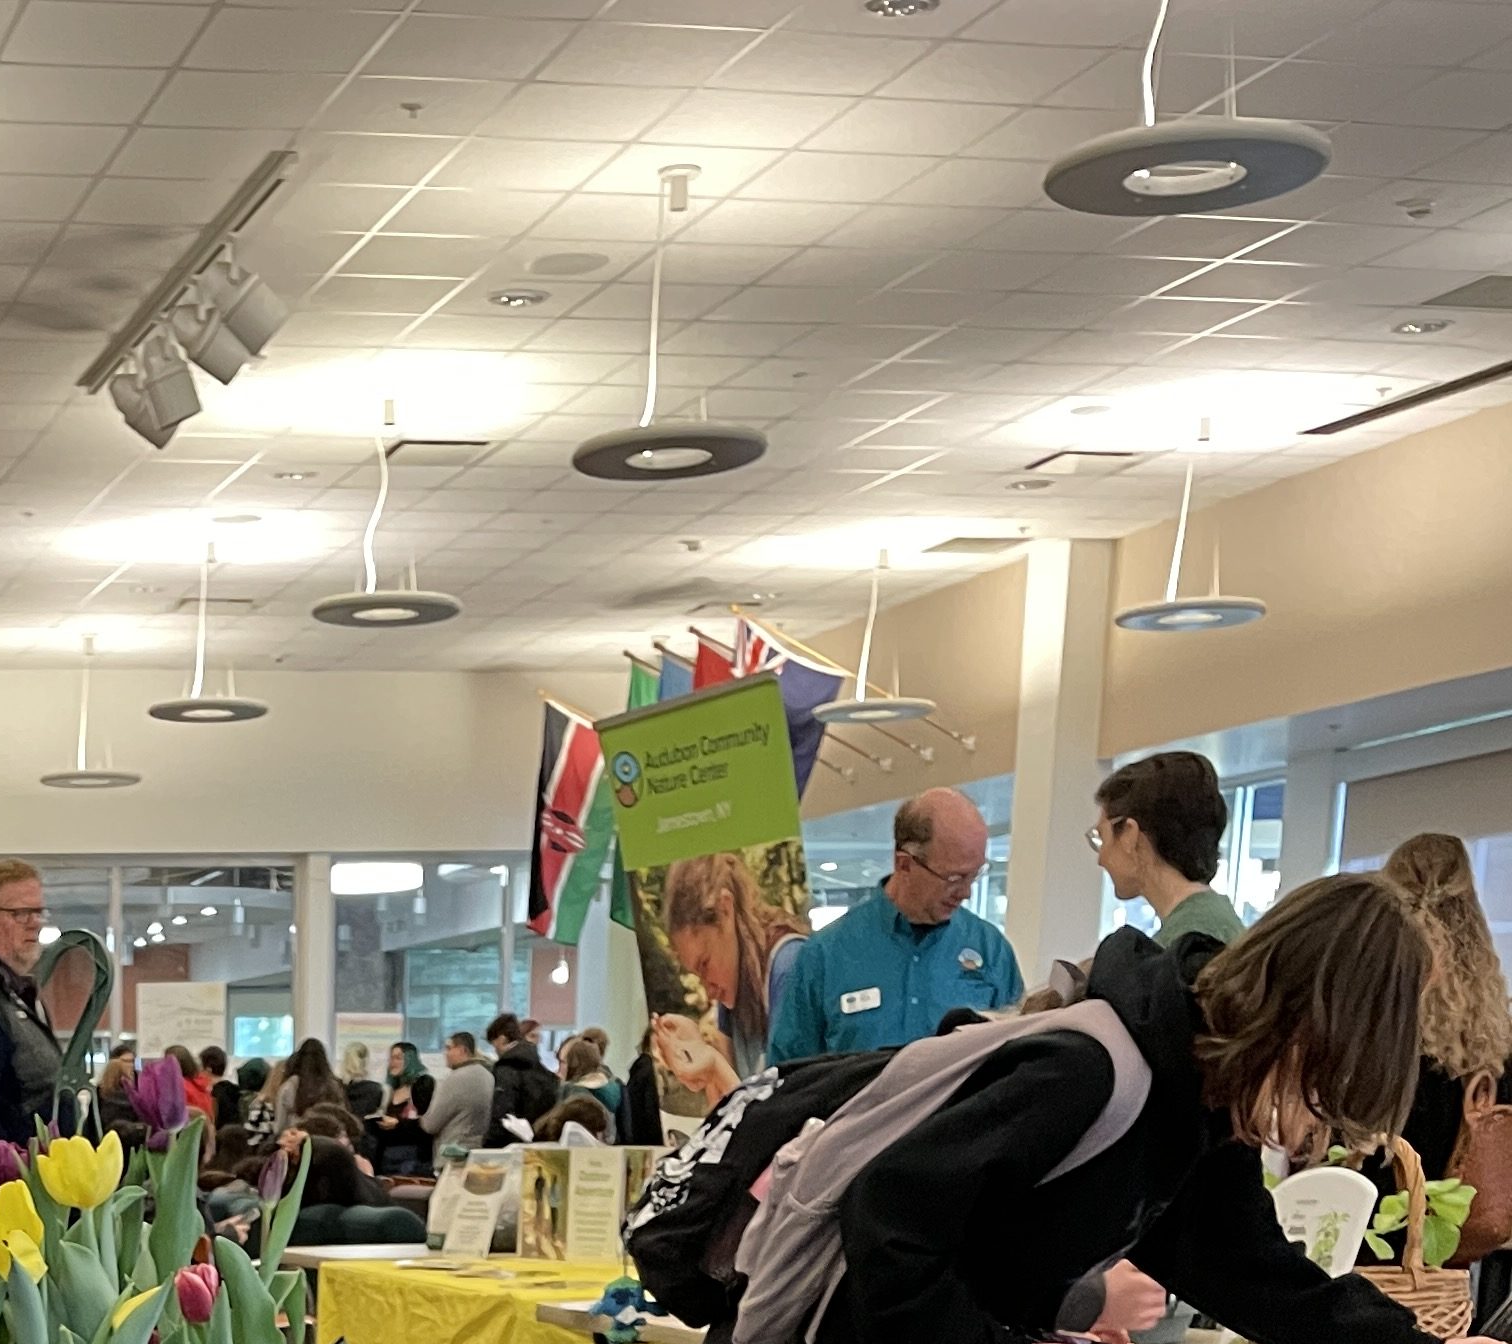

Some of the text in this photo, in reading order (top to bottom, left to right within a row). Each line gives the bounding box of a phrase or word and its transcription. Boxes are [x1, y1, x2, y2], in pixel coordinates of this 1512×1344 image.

[645, 722, 770, 769] Audubon Community
[647, 763, 728, 795] Nature Center
